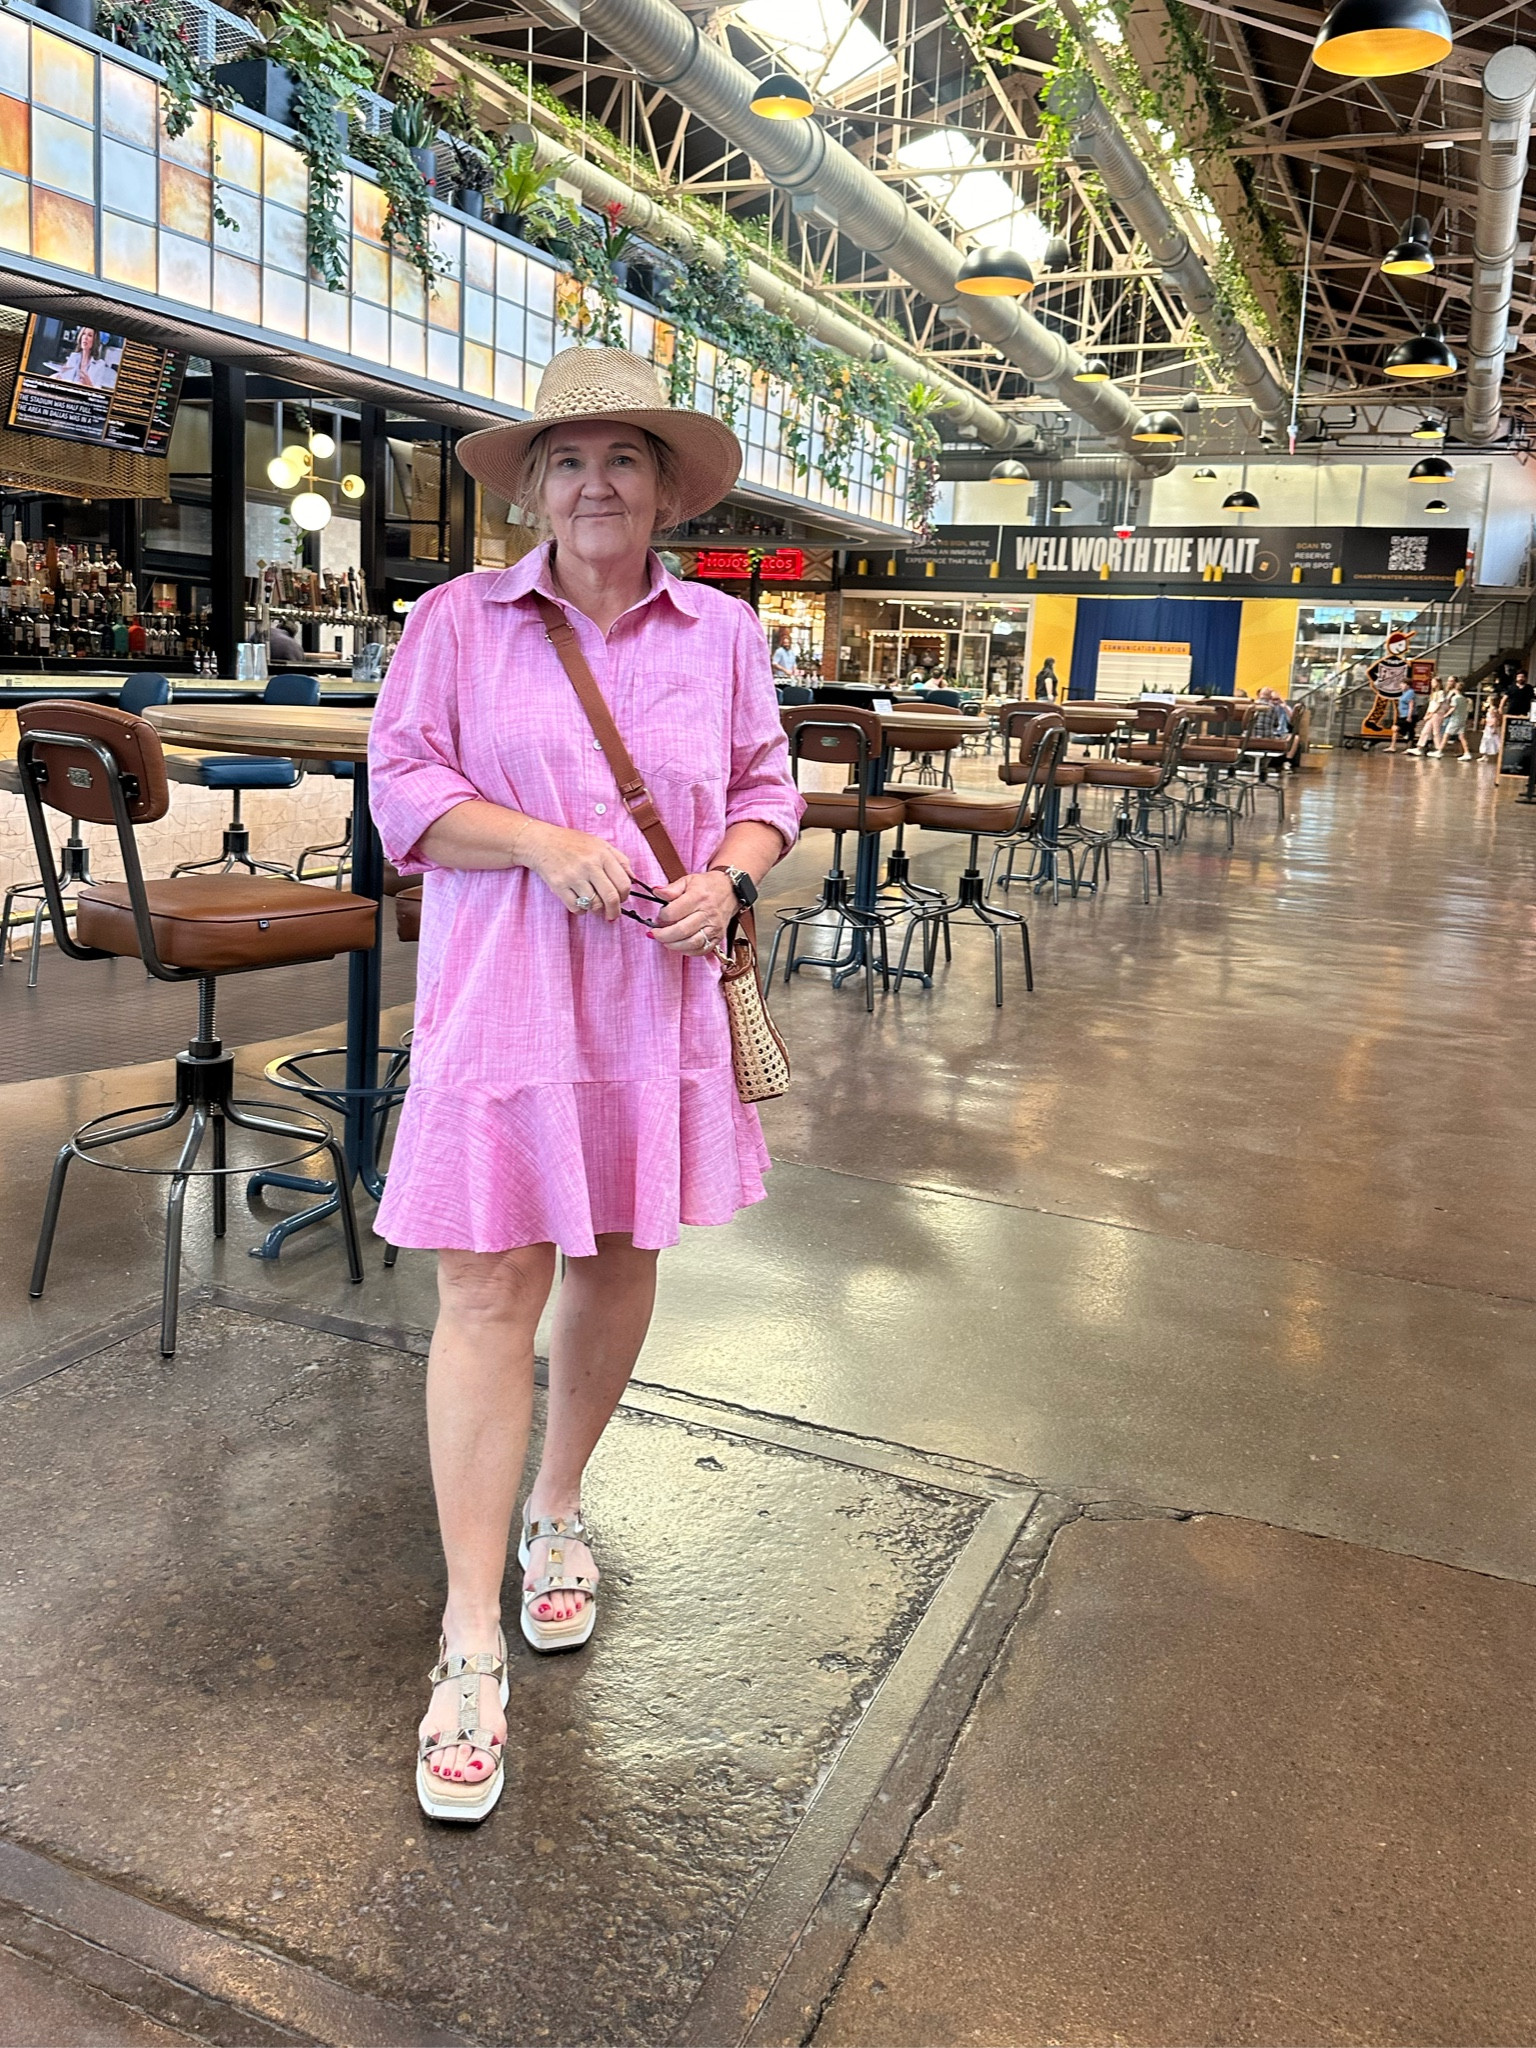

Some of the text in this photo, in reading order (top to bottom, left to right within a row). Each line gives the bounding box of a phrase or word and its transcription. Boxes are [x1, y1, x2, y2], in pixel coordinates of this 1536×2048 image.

[19, 393, 30, 402] THE
[30, 395, 54, 406] STADIUM
[54, 400, 66, 409] WAS
[66, 402, 79, 411] HALF
[18, 403, 28, 412] THE
[28, 405, 42, 414] AREA
[49, 409, 69, 420] DALLAS
[69, 413, 80, 422] WAS
[1296, 542, 1332, 550] SCAN TO
[1016, 536, 1260, 574] WELL WORTH THE WAIT
[1294, 552, 1331, 560] RESERVE
[707, 558, 793, 569] MOJO'S ACOS
[948, 557, 966, 565] THAT
[1289, 561, 1335, 570] YOUR SPOT
[1104, 644, 1186, 654] COMMUNICATION STATION
